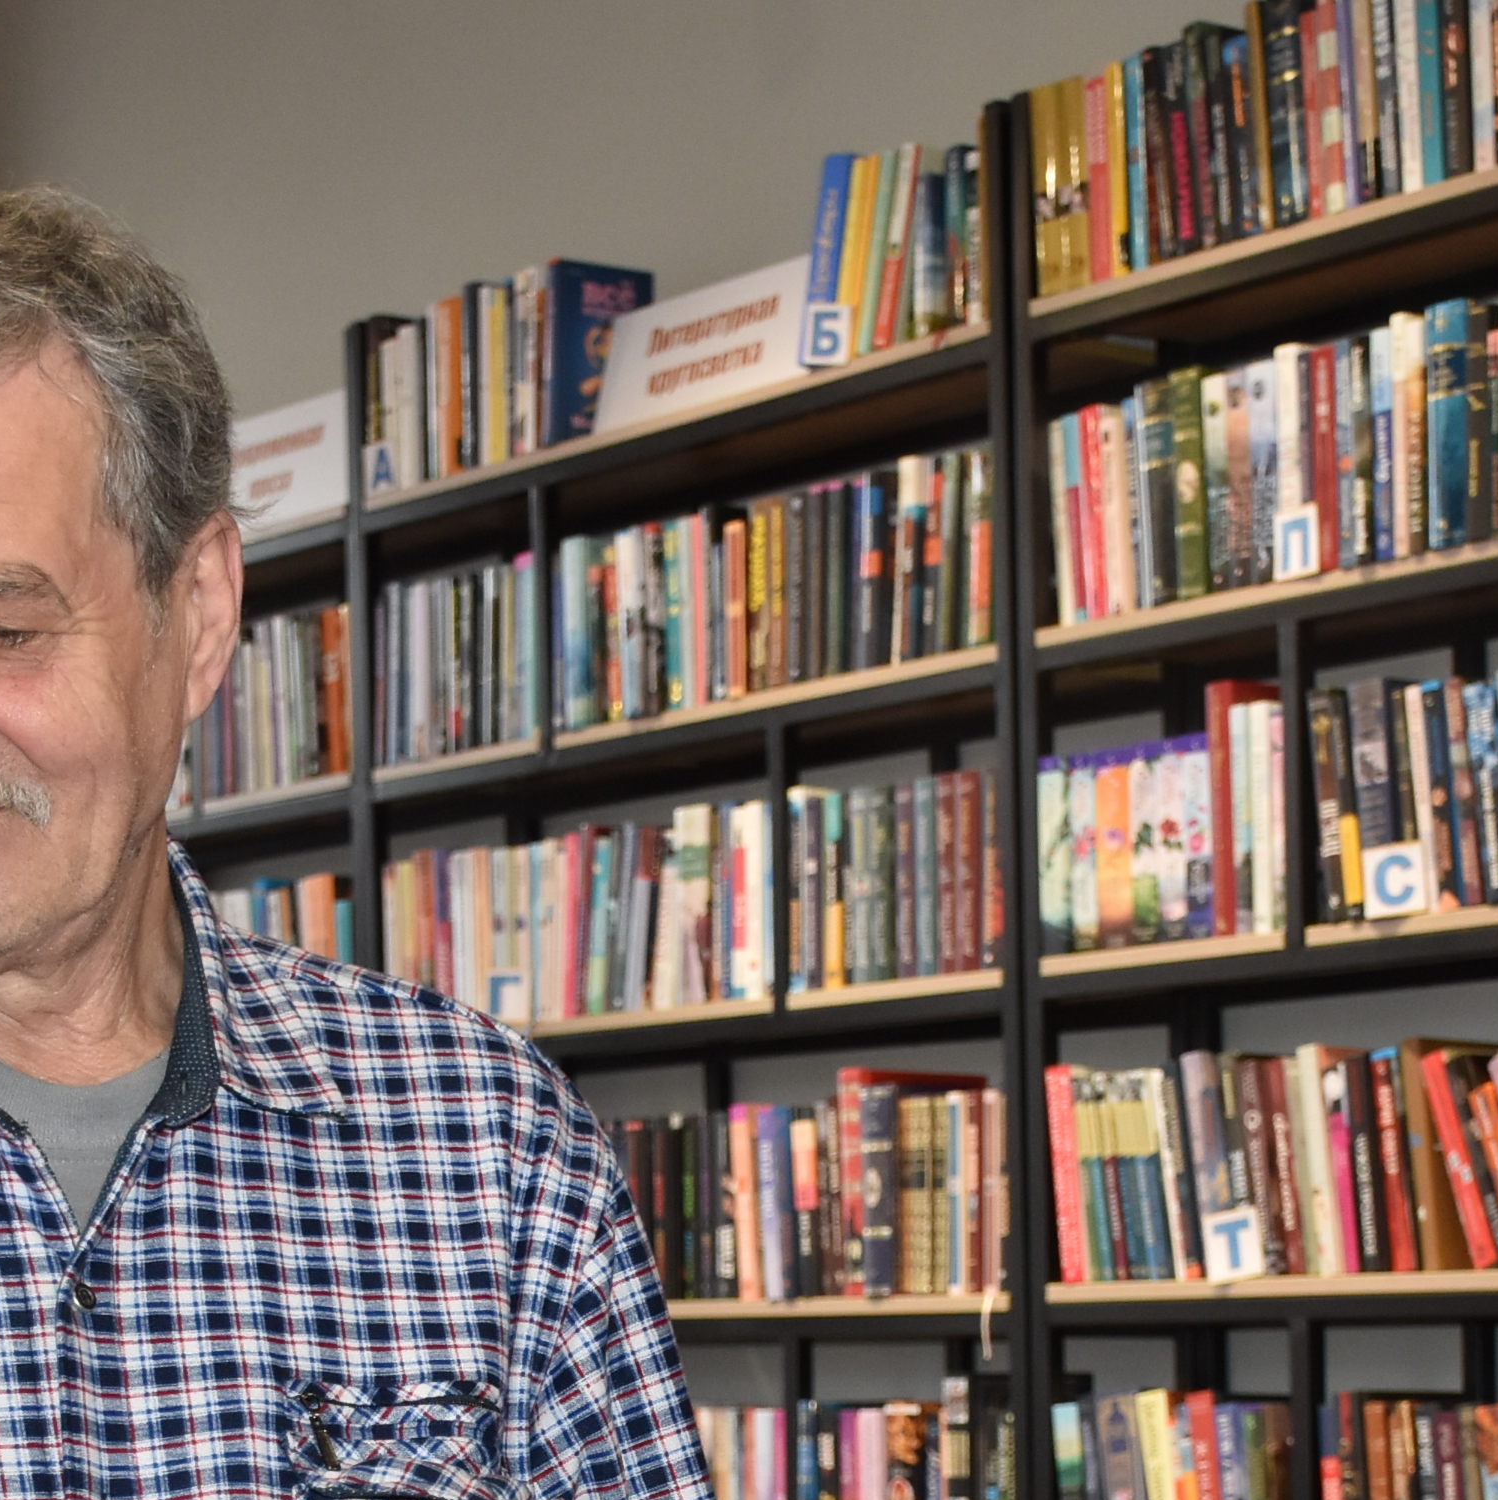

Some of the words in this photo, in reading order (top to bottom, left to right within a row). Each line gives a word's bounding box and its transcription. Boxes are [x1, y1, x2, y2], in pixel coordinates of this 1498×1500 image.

[811, 312, 839, 356] Б
[371, 448, 395, 486] А
[1280, 516, 1311, 570] П
[1373, 854, 1416, 905] С
[1214, 1217, 1251, 1272] Т
